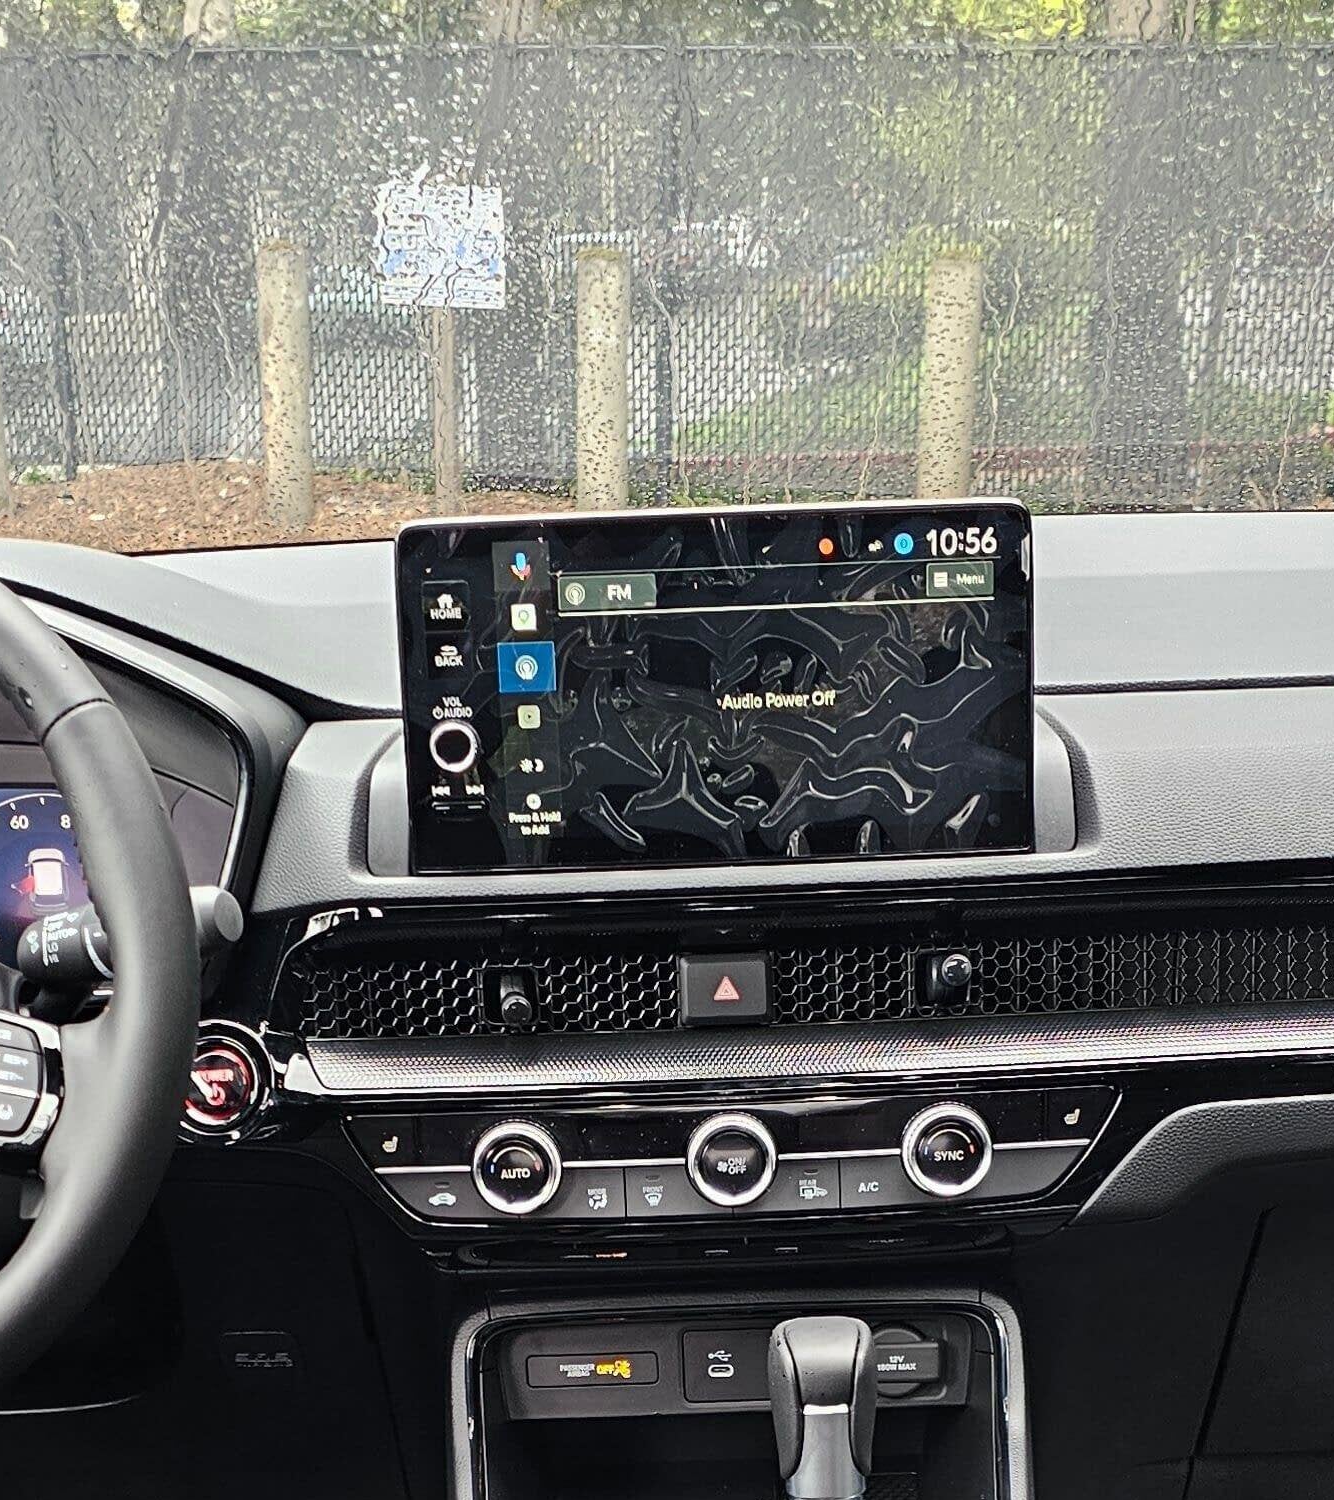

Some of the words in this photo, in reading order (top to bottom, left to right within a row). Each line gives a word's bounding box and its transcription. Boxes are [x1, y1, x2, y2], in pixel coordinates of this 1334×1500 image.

[926, 527, 997, 556] 10:56
[956, 573, 985, 585] Menu
[607, 583, 632, 601] FM
[430, 608, 462, 620] HOME
[434, 655, 464, 667] BACK
[442, 696, 463, 707] VOL
[721, 693, 763, 710] Audio
[765, 692, 809, 709] Power
[811, 690, 836, 706] Off
[444, 706, 473, 718] AUDIO
[9, 815, 29, 831] 60
[60, 815, 71, 830] 8
[508, 812, 532, 824] Press
[539, 810, 562, 822] Hold
[520, 824, 532, 836] to
[531, 824, 550, 835] Add
[933, 1150, 965, 1162] SYNC
[501, 1168, 530, 1180] AUTO
[728, 1165, 747, 1175] OFF
[857, 1181, 879, 1193] A/C
[898, 1362, 917, 1371] MAX
